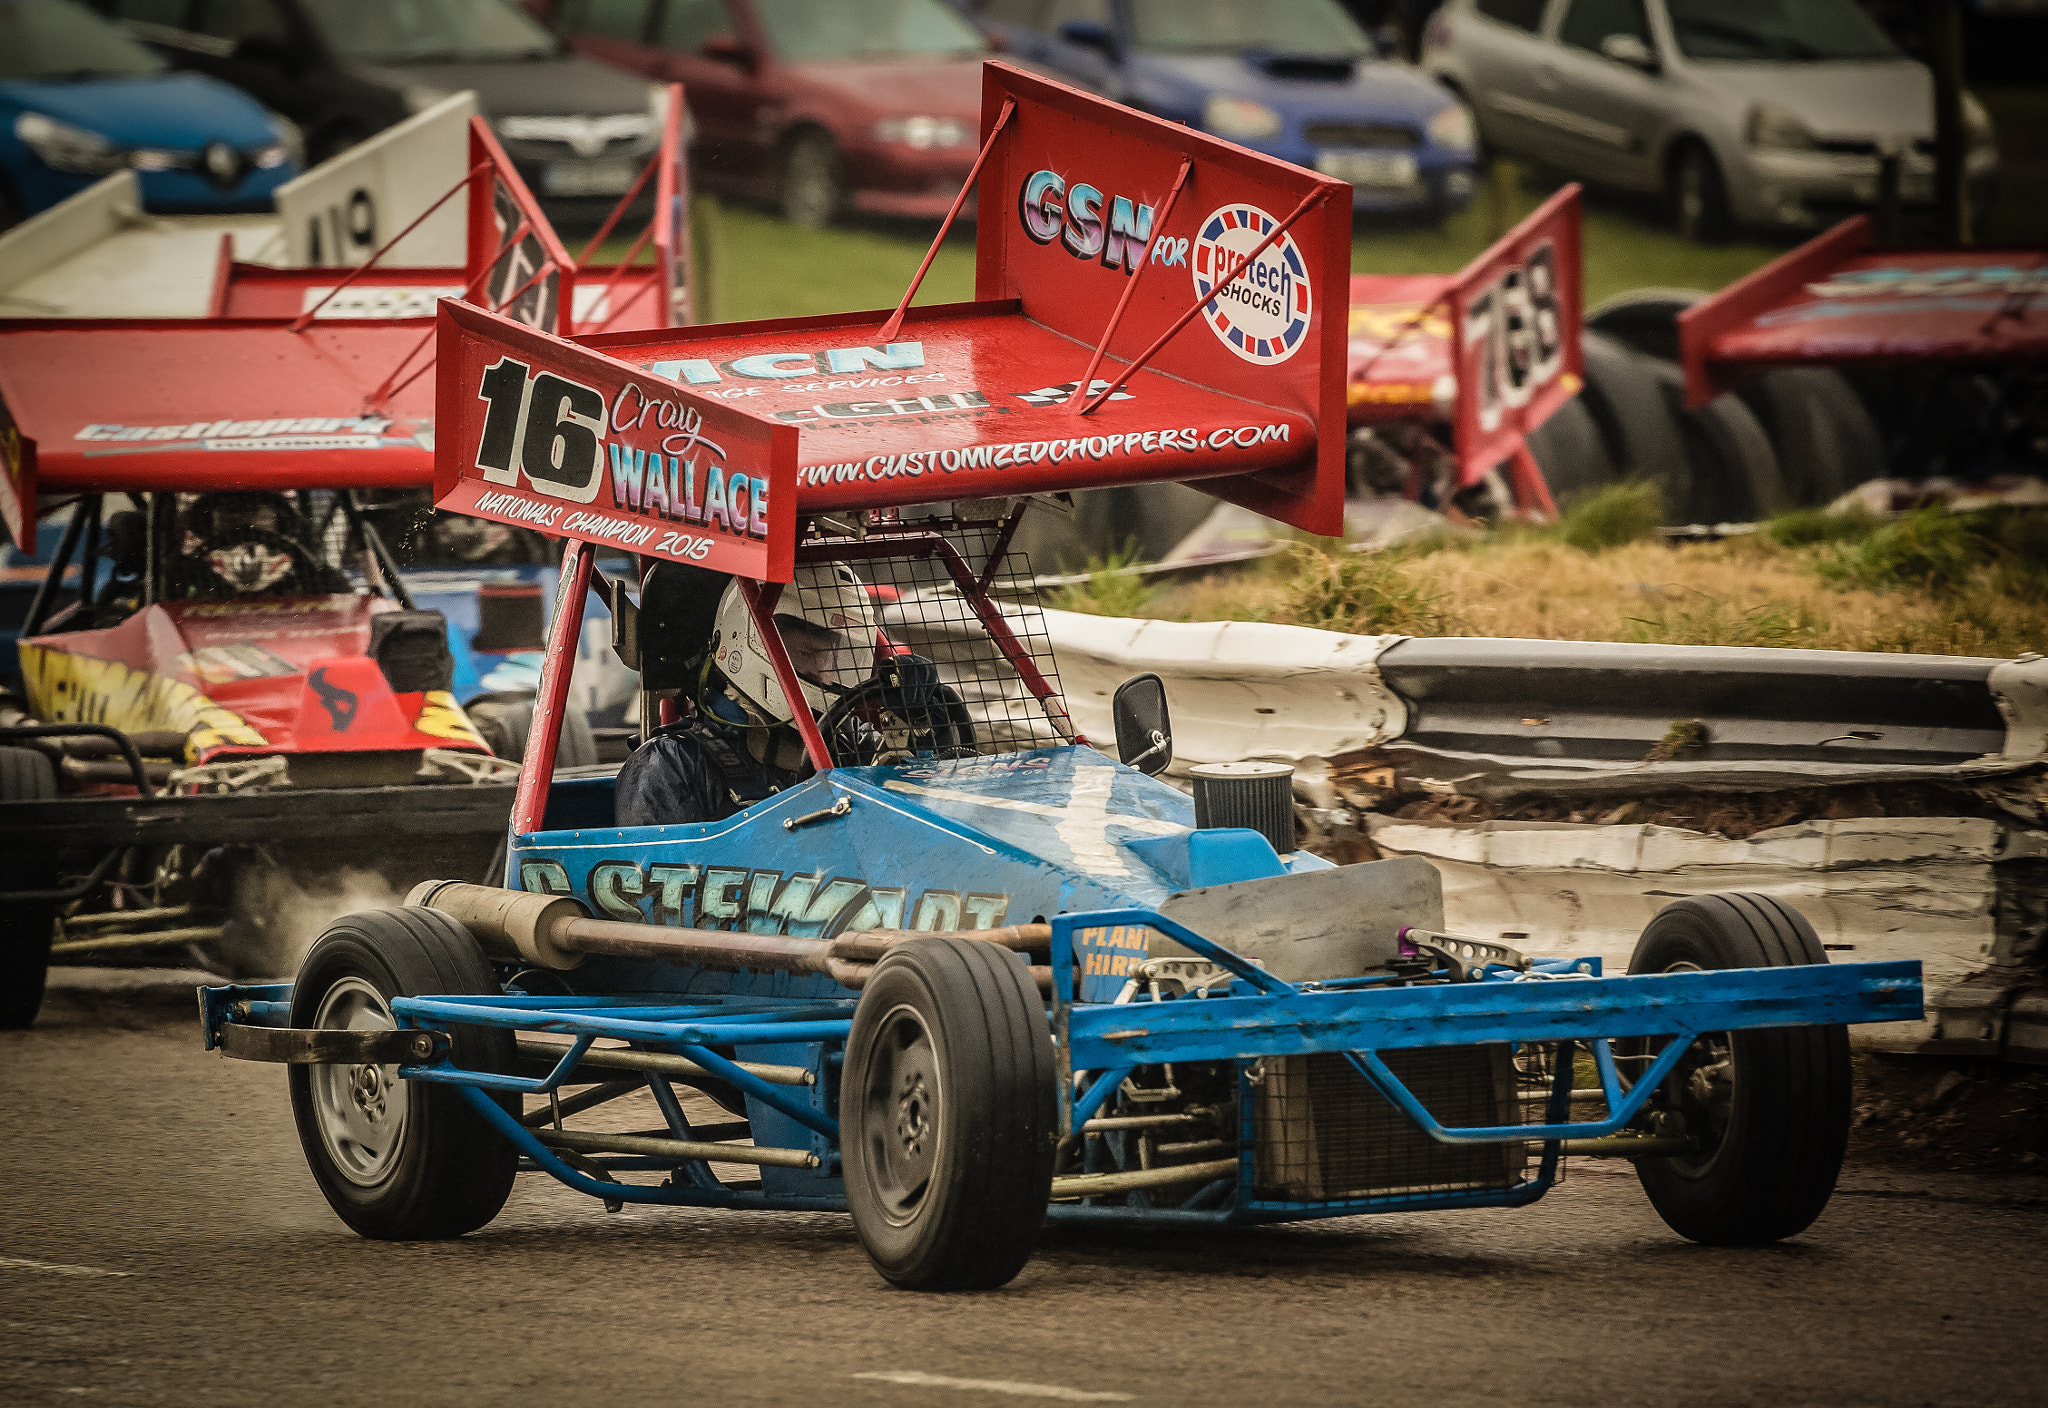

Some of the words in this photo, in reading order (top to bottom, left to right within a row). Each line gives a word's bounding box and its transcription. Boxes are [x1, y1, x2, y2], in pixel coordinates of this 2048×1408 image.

[1018, 169, 1156, 277] GSN
[1151, 235, 1189, 269] FOR
[1213, 243, 1291, 323] protech
[1221, 280, 1281, 317] SHOCKS
[610, 382, 727, 459] Craig
[780, 373, 948, 394] SERVICES
[476, 355, 607, 503] 16
[475, 490, 563, 527] NATIONALS
[561, 513, 656, 547] CHAMPION
[654, 530, 715, 561] 2015
[609, 442, 768, 536] WALLACE
